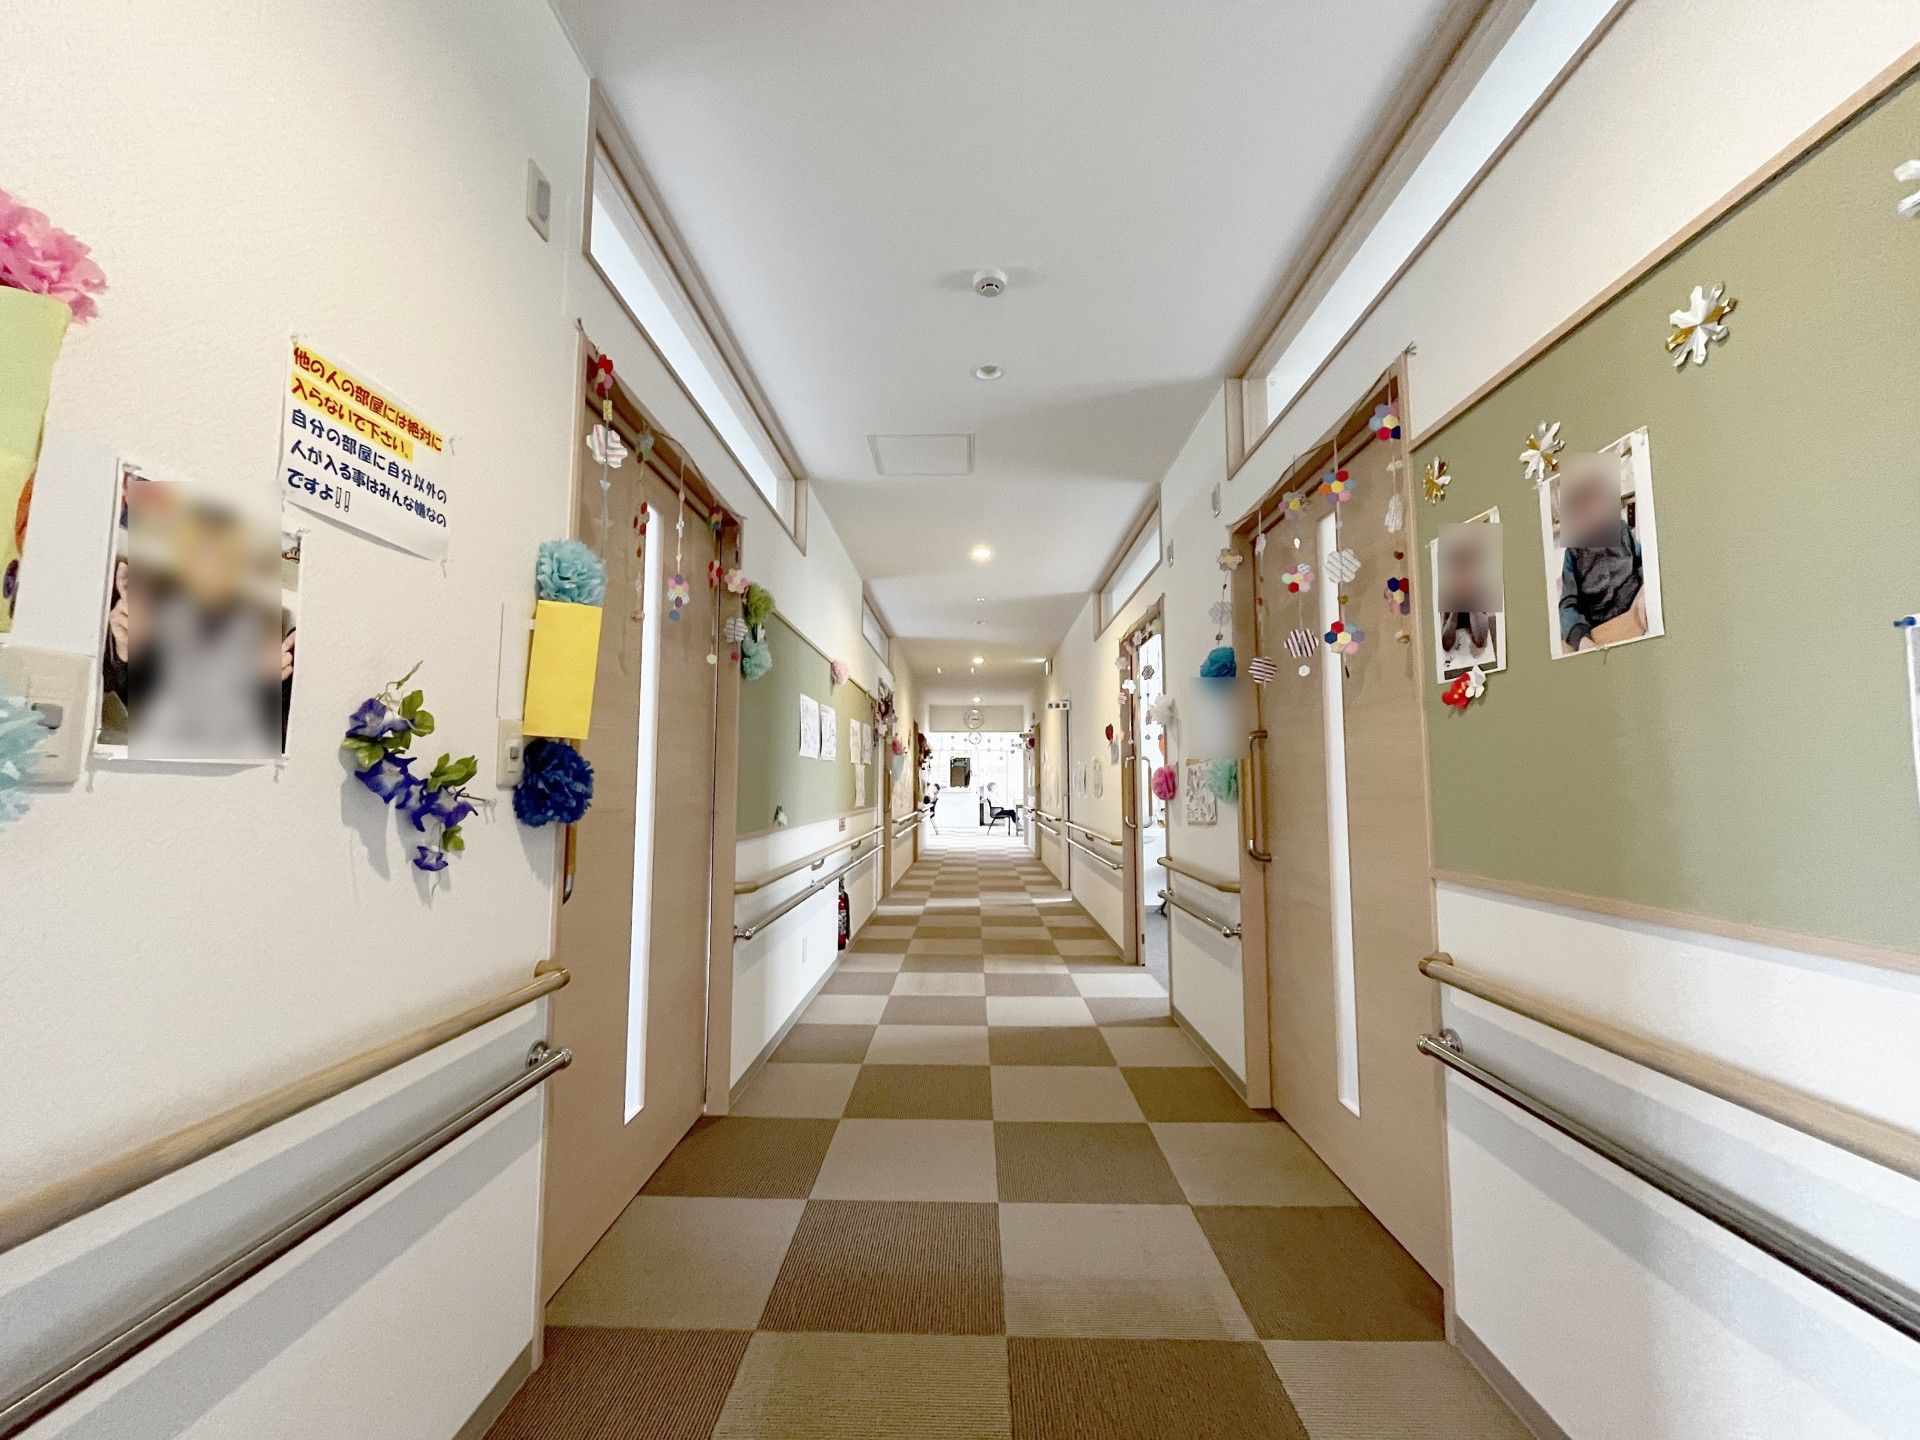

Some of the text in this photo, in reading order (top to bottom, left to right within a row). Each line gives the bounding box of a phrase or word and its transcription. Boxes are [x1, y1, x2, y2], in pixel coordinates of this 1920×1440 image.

[292, 377, 410, 459] 入らないで下さい。
[294, 346, 442, 452] 他の人の部屋には絶対に
[292, 408, 447, 504] 自分の部屋に自分以外の
